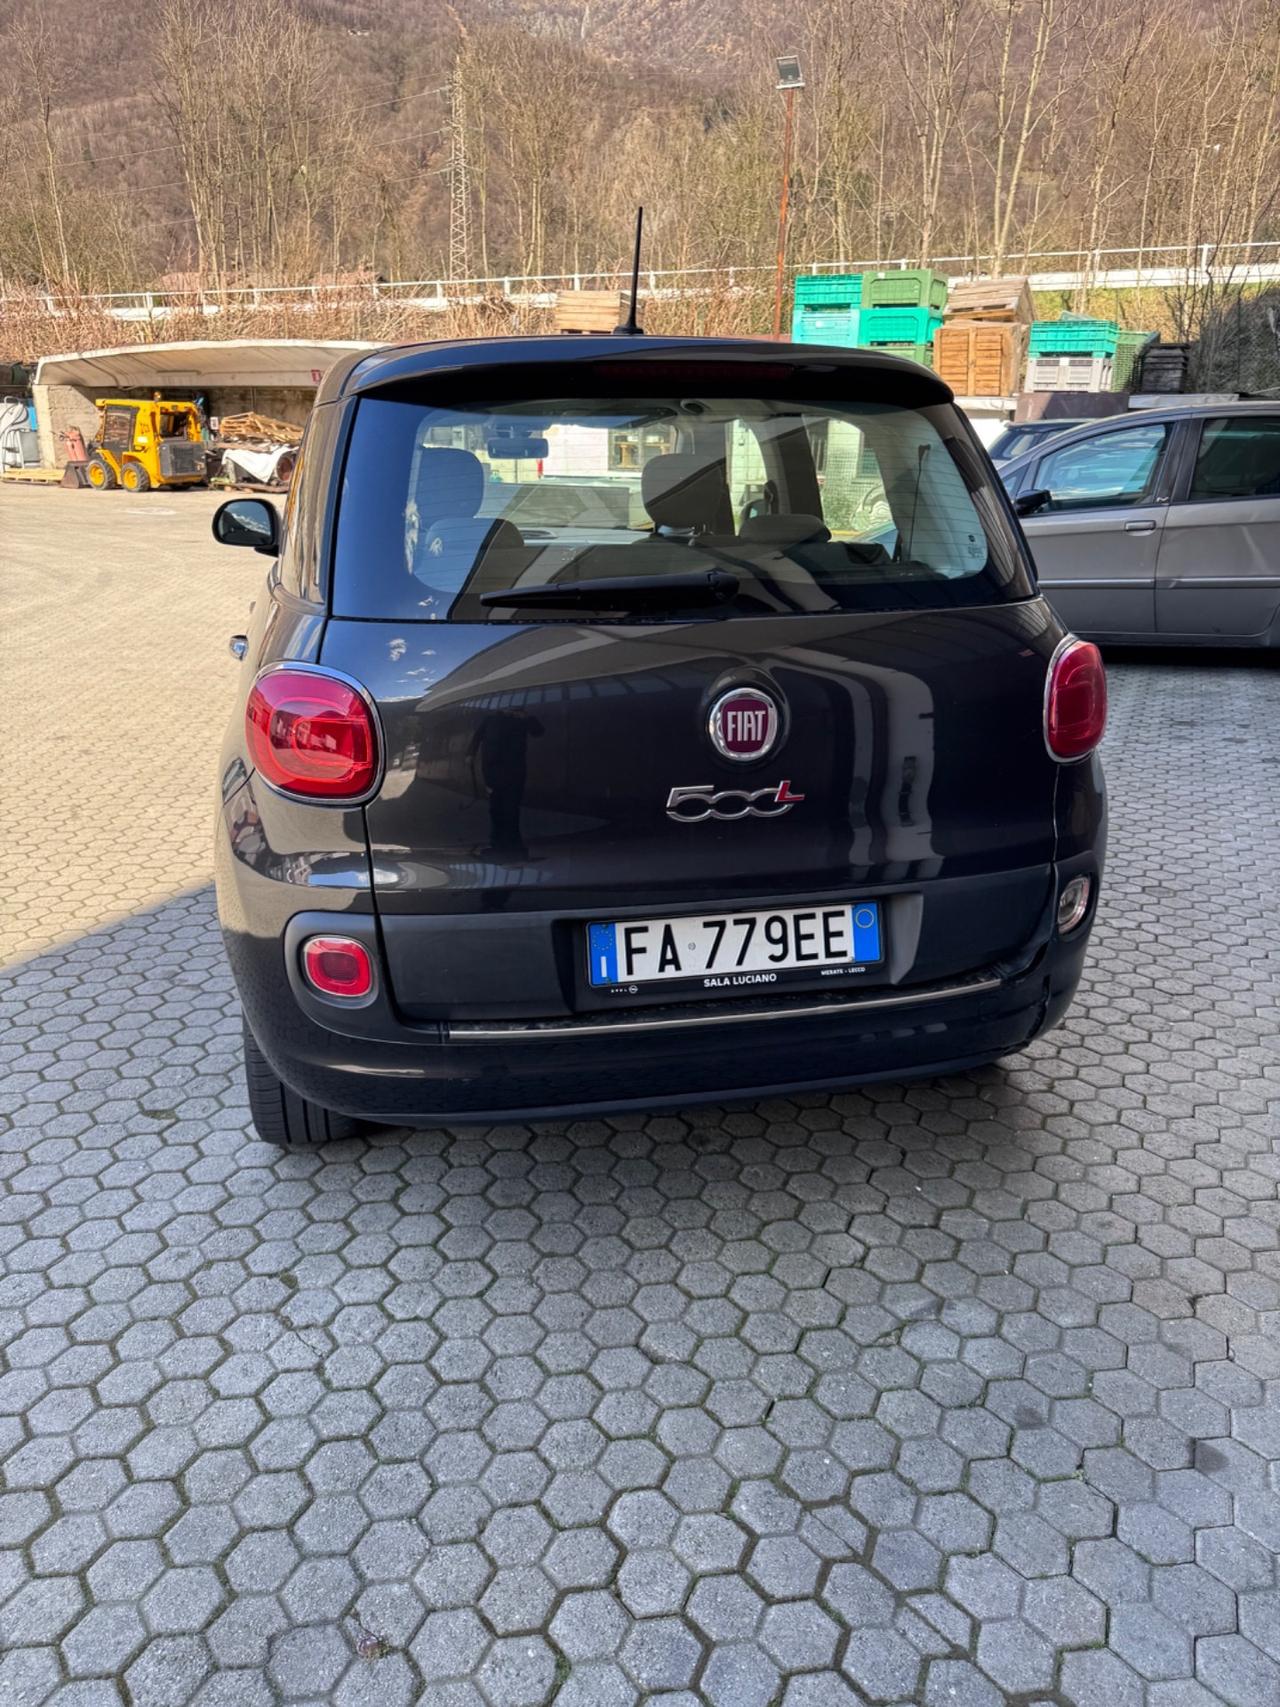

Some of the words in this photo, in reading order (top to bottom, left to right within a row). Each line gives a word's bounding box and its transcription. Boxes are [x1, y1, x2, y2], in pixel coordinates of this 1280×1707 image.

[727, 710, 766, 742] FIAT
[666, 780, 805, 822] 500L
[624, 924, 682, 976] FA
[702, 910, 848, 969] 779EE
[703, 977, 731, 988] SALA
[733, 973, 777, 985] LUCIANO
